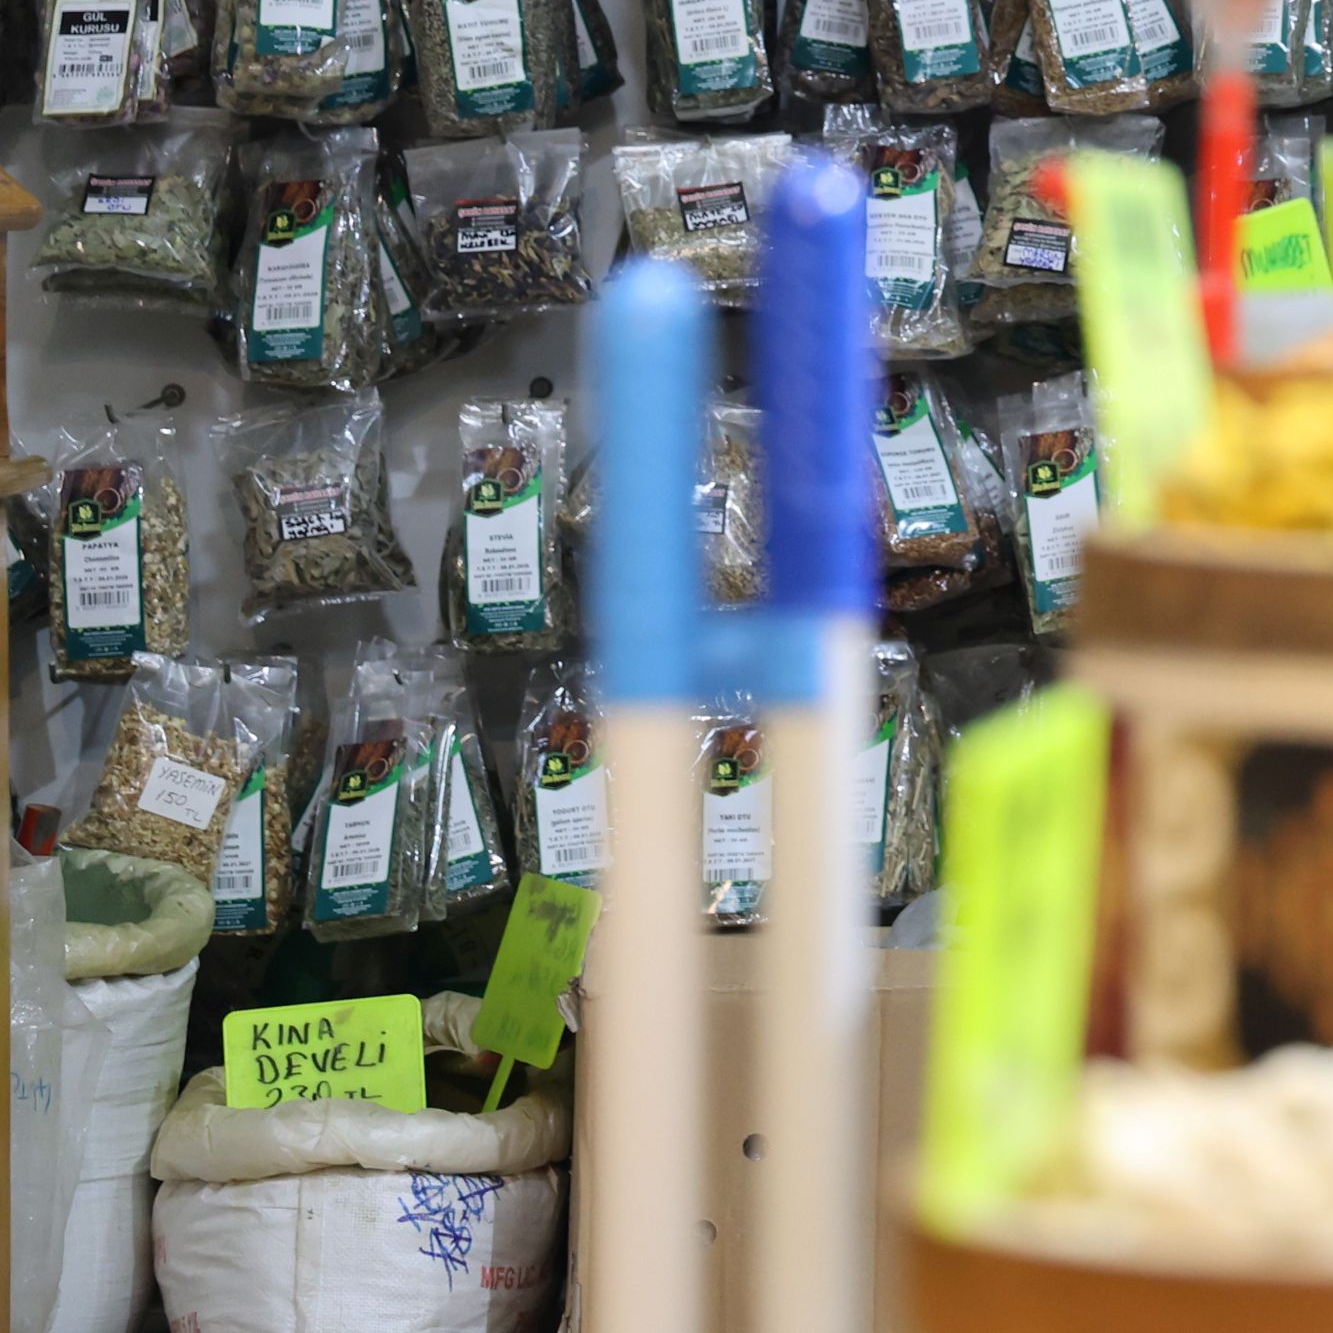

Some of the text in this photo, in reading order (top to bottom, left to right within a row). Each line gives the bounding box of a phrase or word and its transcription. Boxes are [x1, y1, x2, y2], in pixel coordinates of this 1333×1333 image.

[70, 22, 120, 34] KURUSU
[82, 541, 120, 550] PAPATYA
[160, 766, 222, 797] YASEMİN
[156, 789, 188, 807] 150
[252, 1017, 335, 1051] KINA
[256, 1031, 388, 1084] DEVELİ
